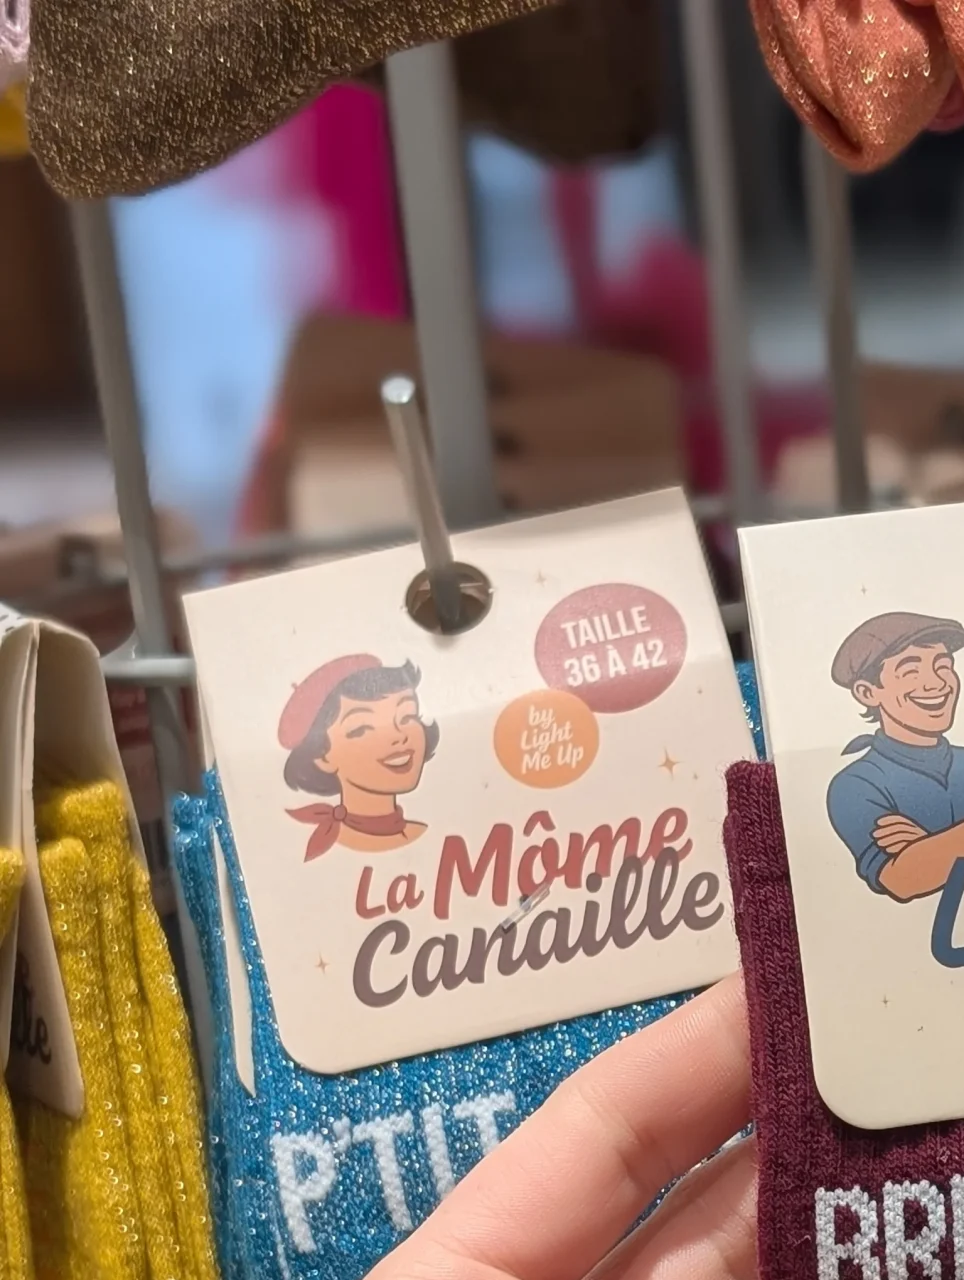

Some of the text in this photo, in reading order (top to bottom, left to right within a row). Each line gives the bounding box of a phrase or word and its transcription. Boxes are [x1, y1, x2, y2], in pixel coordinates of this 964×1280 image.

[560, 605, 651, 650] TAILLE
[563, 638, 668, 688] 36 À 42
[520, 720, 574, 755] Light
[528, 704, 556, 730] by
[521, 742, 584, 775] Me Up
[355, 807, 694, 920] La Môme
[352, 846, 725, 1008] Canaille
[269, 1089, 516, 1253] P'TIT
